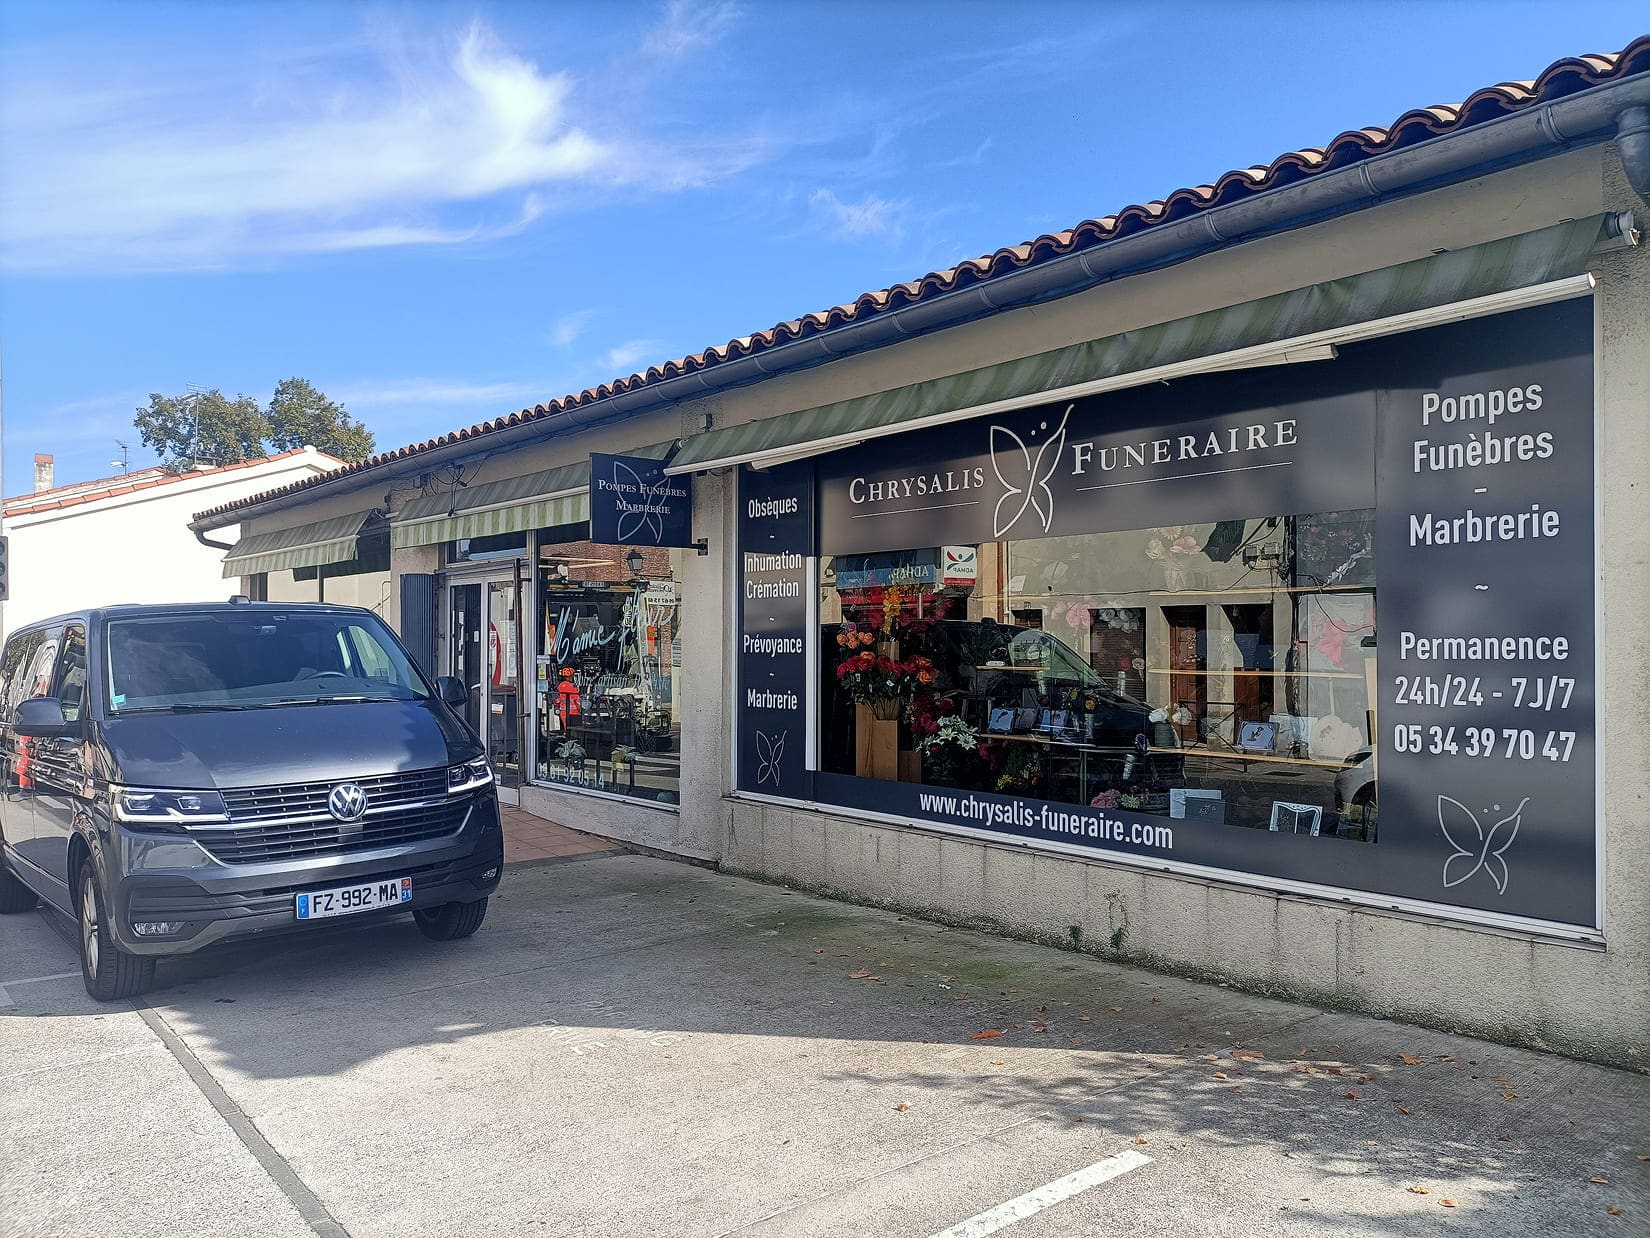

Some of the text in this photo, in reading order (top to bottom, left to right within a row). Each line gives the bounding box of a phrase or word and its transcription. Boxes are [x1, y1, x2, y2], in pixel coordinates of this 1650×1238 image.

[1422, 384, 1544, 426] Pompes
[849, 419, 1299, 504] CHRYSALIS FUNERAIRE
[1414, 431, 1554, 474] Funèbres
[598, 479, 637, 493] POMPES
[615, 499, 671, 514] MARBRERIE
[748, 496, 798, 520] Obsèques
[1409, 503, 1560, 547] Marbrerie
[744, 549, 802, 573] Inhumation
[746, 578, 799, 599] Crémation
[743, 634, 802, 658] Prévoyance
[1400, 631, 1569, 661] Permanence
[746, 688, 798, 710] Marbrerie
[1394, 674, 1484, 708] 24h/24
[1511, 675, 1576, 711] 7J/7
[1394, 724, 1577, 762] 05 34 39 70 47
[578, 768, 589, 786] 05
[919, 793, 1174, 849] www.chrysalis-funeraire.com
[312, 883, 398, 913] FZ-992-MA
